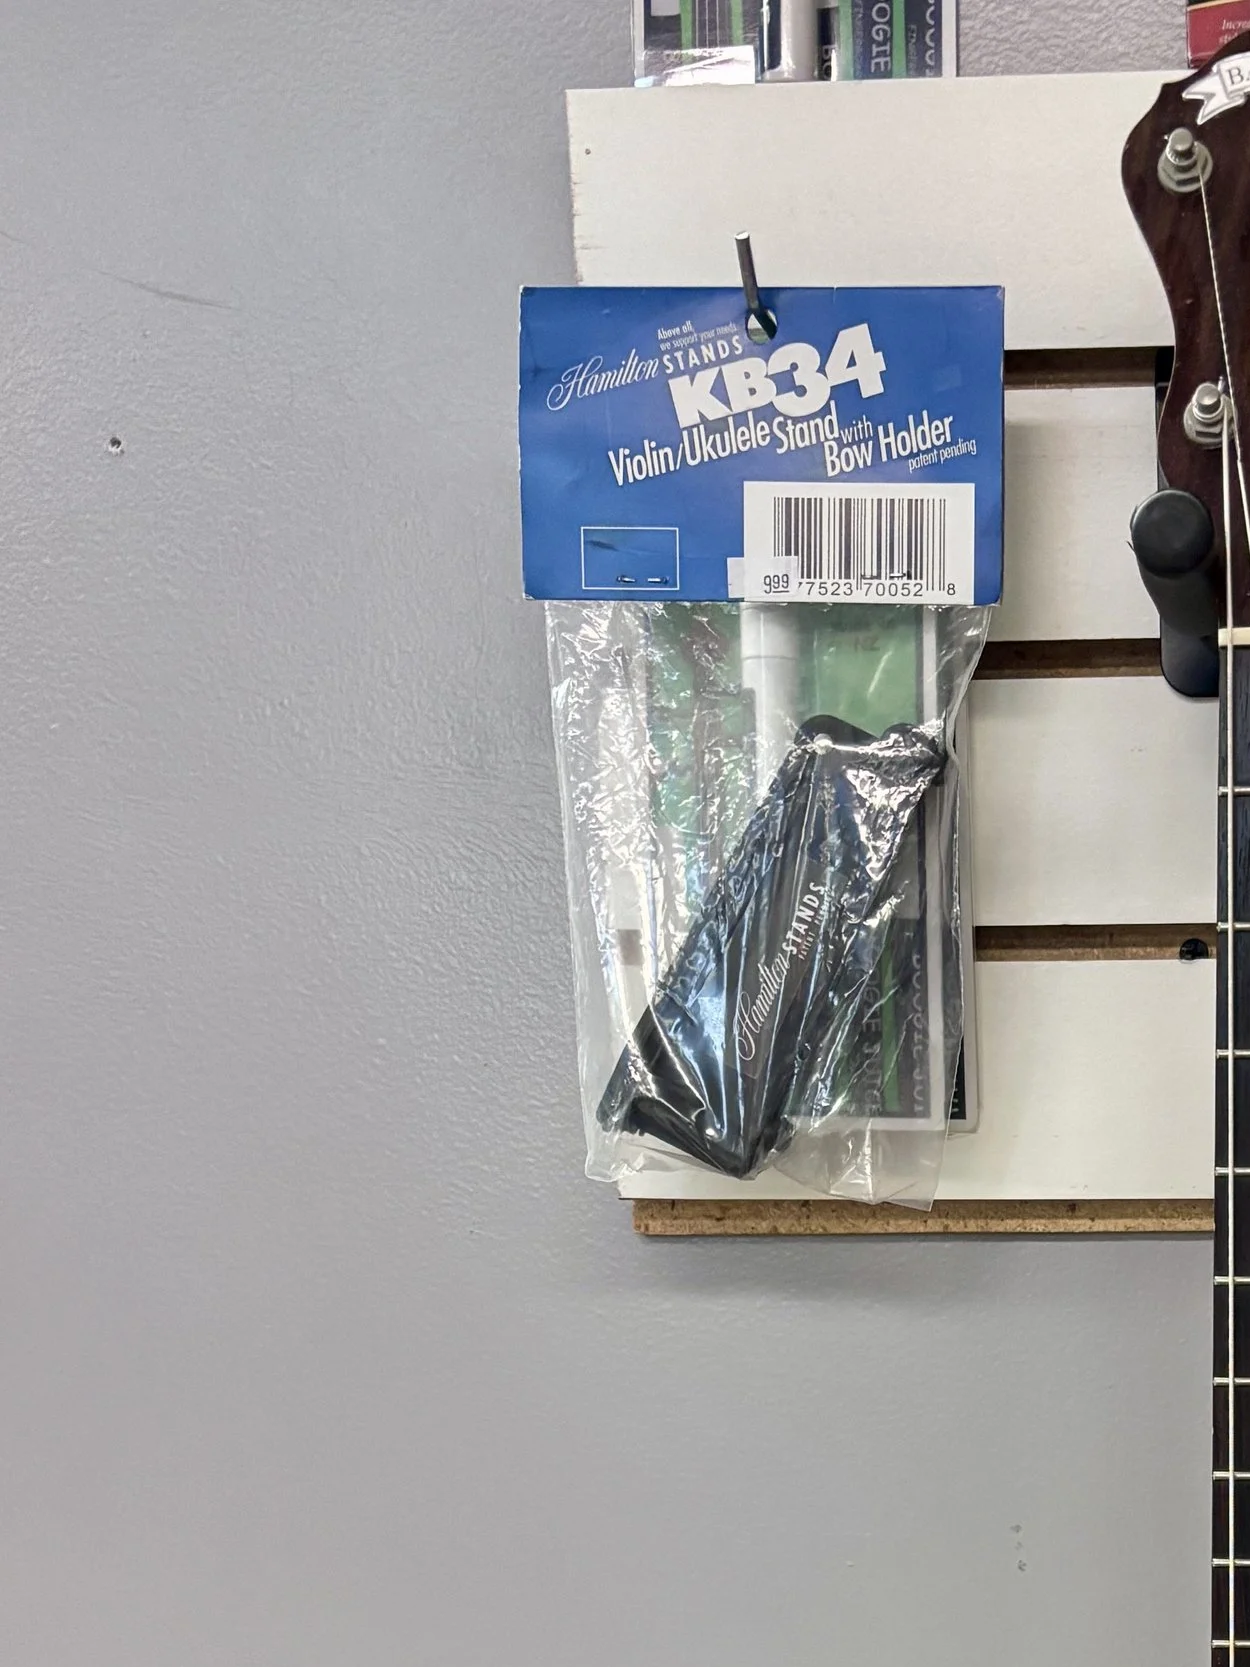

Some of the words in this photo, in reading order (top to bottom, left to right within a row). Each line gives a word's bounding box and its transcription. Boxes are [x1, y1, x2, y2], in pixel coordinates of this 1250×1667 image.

[871, 0, 891, 72] OGIE
[657, 325, 681, 340] Above
[546, 348, 660, 411] Hamilton
[663, 335, 743, 374] STANDS
[667, 322, 888, 429] KB34
[772, 400, 840, 455] Stand
[840, 415, 874, 443] with
[825, 440, 874, 478] Bow
[877, 410, 955, 462] Holder
[908, 450, 939, 473] patent
[939, 438, 977, 465] pending
[798, 582, 853, 596] 7523
[863, 582, 923, 597] 70052
[947, 583, 956, 596] 8
[735, 955, 792, 1060] Hamilton
[783, 882, 823, 955] STANDS
